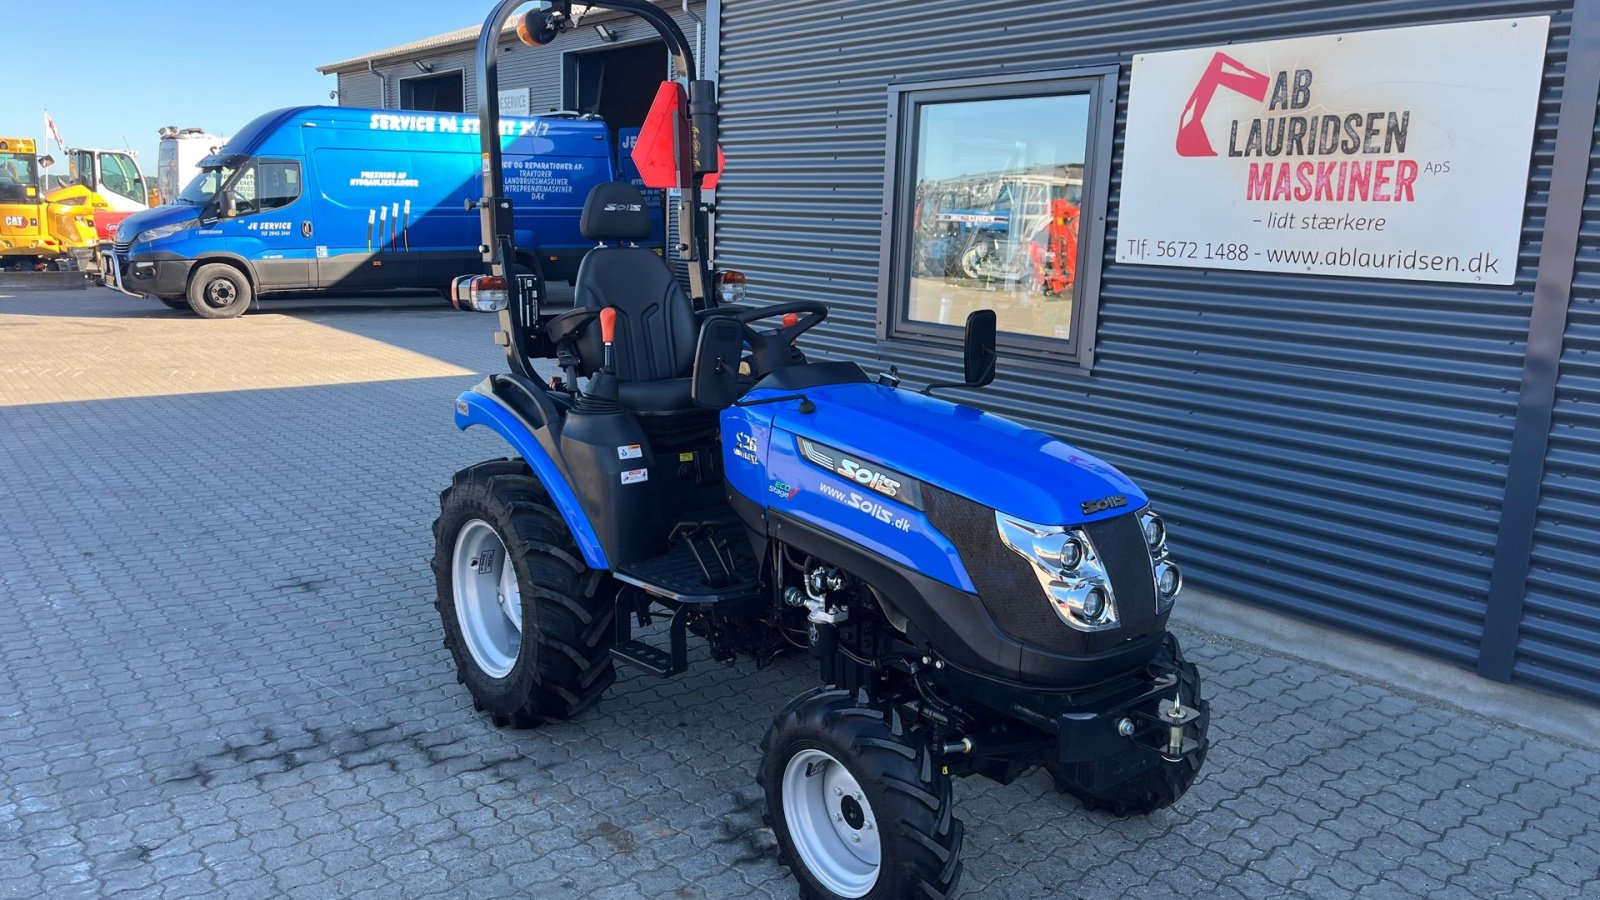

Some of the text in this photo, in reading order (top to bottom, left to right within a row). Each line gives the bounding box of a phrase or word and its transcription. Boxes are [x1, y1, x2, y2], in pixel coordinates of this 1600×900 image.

[1269, 69, 1313, 111] AB
[370, 114, 435, 133] SERVICE
[439, 115, 458, 133] PÅ
[1228, 111, 1410, 157] LAURIDSEN
[520, 170, 552, 178] TRAKTORER
[525, 162, 573, 171] REPARATIONER
[505, 177, 568, 186] LANDBRUGSMASKINER
[1246, 160, 1450, 201] MASKINER ApS
[6, 216, 23, 226] CAT
[248, 222, 292, 230] JE SERVICE
[1267, 212, 1295, 229] lidt
[1301, 213, 1386, 231] stærkere
[1127, 239, 1150, 260] Tlf.
[1157, 241, 1197, 259] 5672
[1204, 243, 1249, 261] 1488
[1266, 247, 1499, 273] www.ablauridsen.dk
[775, 480, 790, 491] ECO
